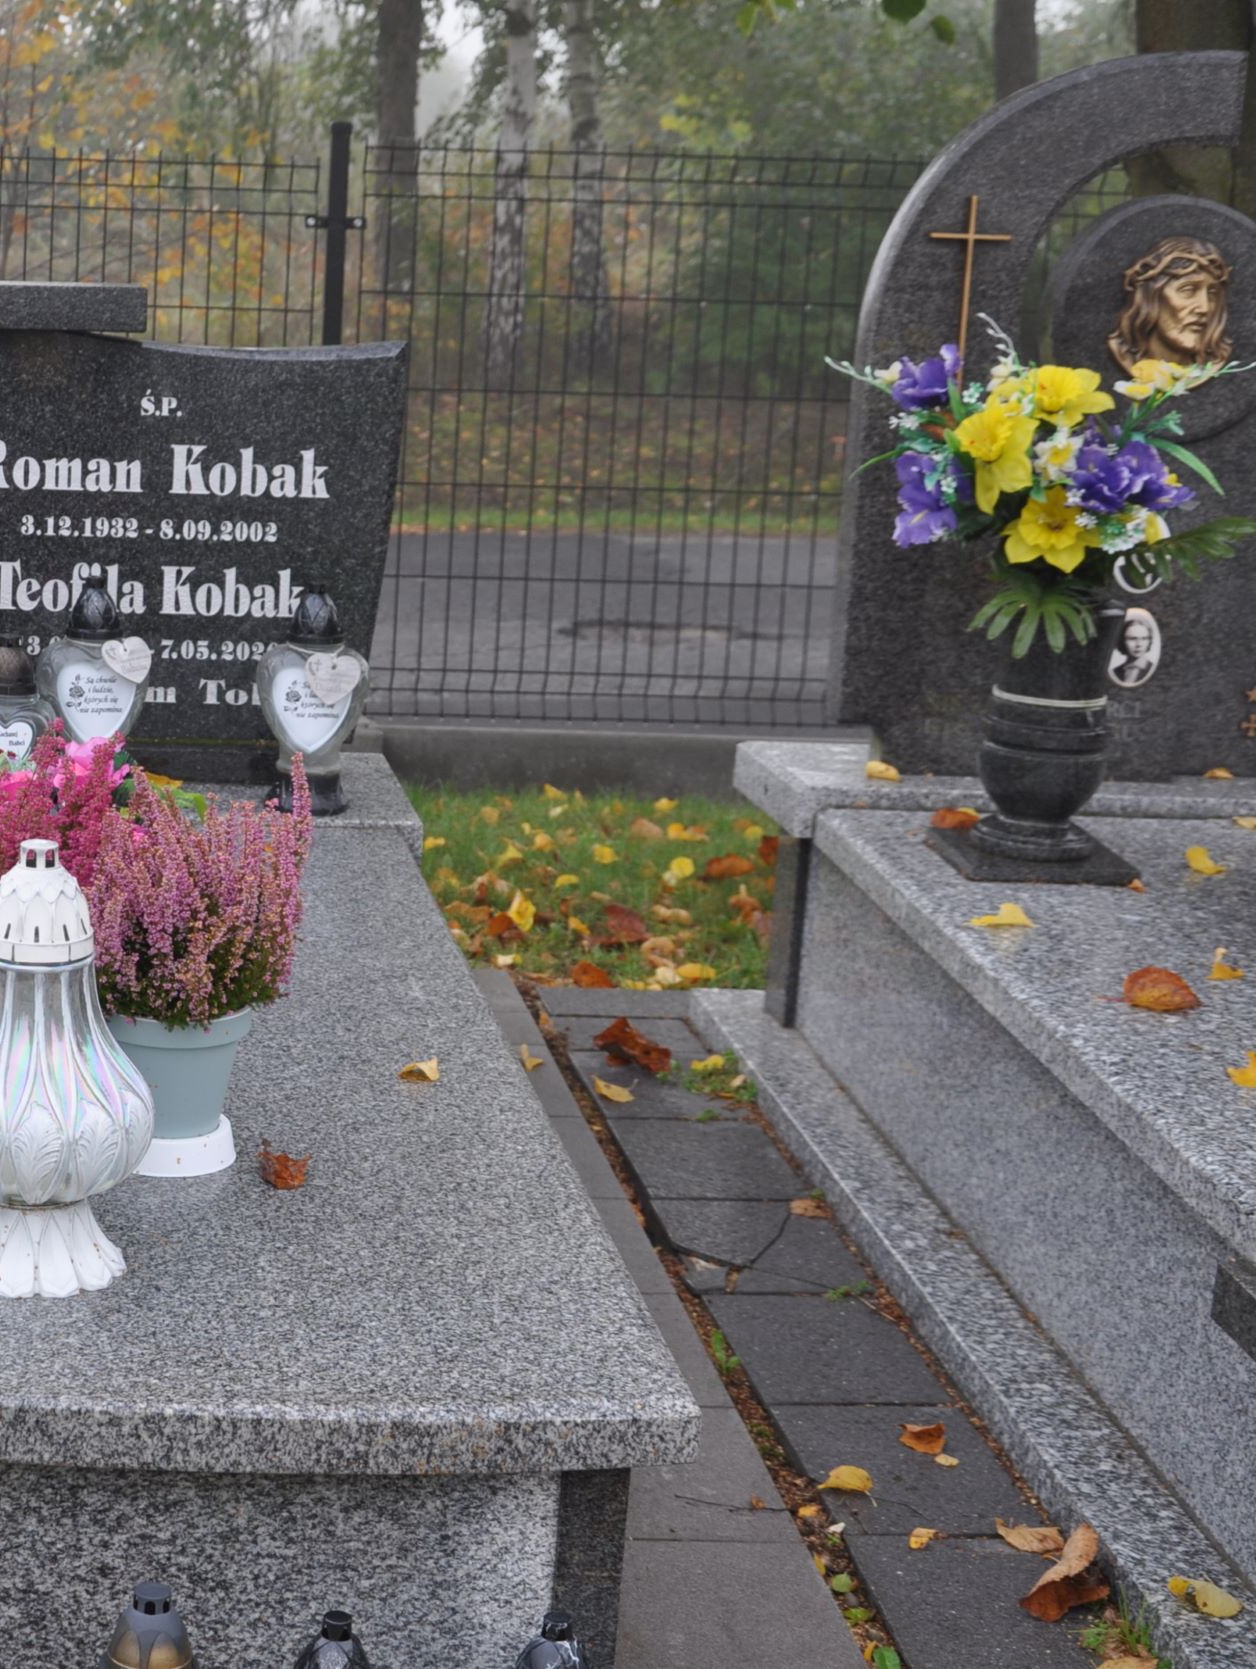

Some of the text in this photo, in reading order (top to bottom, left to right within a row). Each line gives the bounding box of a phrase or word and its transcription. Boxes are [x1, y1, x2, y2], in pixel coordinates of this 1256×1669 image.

[140, 389, 183, 417] Ś.P.
[169, 443, 331, 499] Kobak
[20, 514, 139, 538] 3.12.1932
[159, 518, 278, 543] 8.09.2002
[159, 565, 306, 618] Kobak
